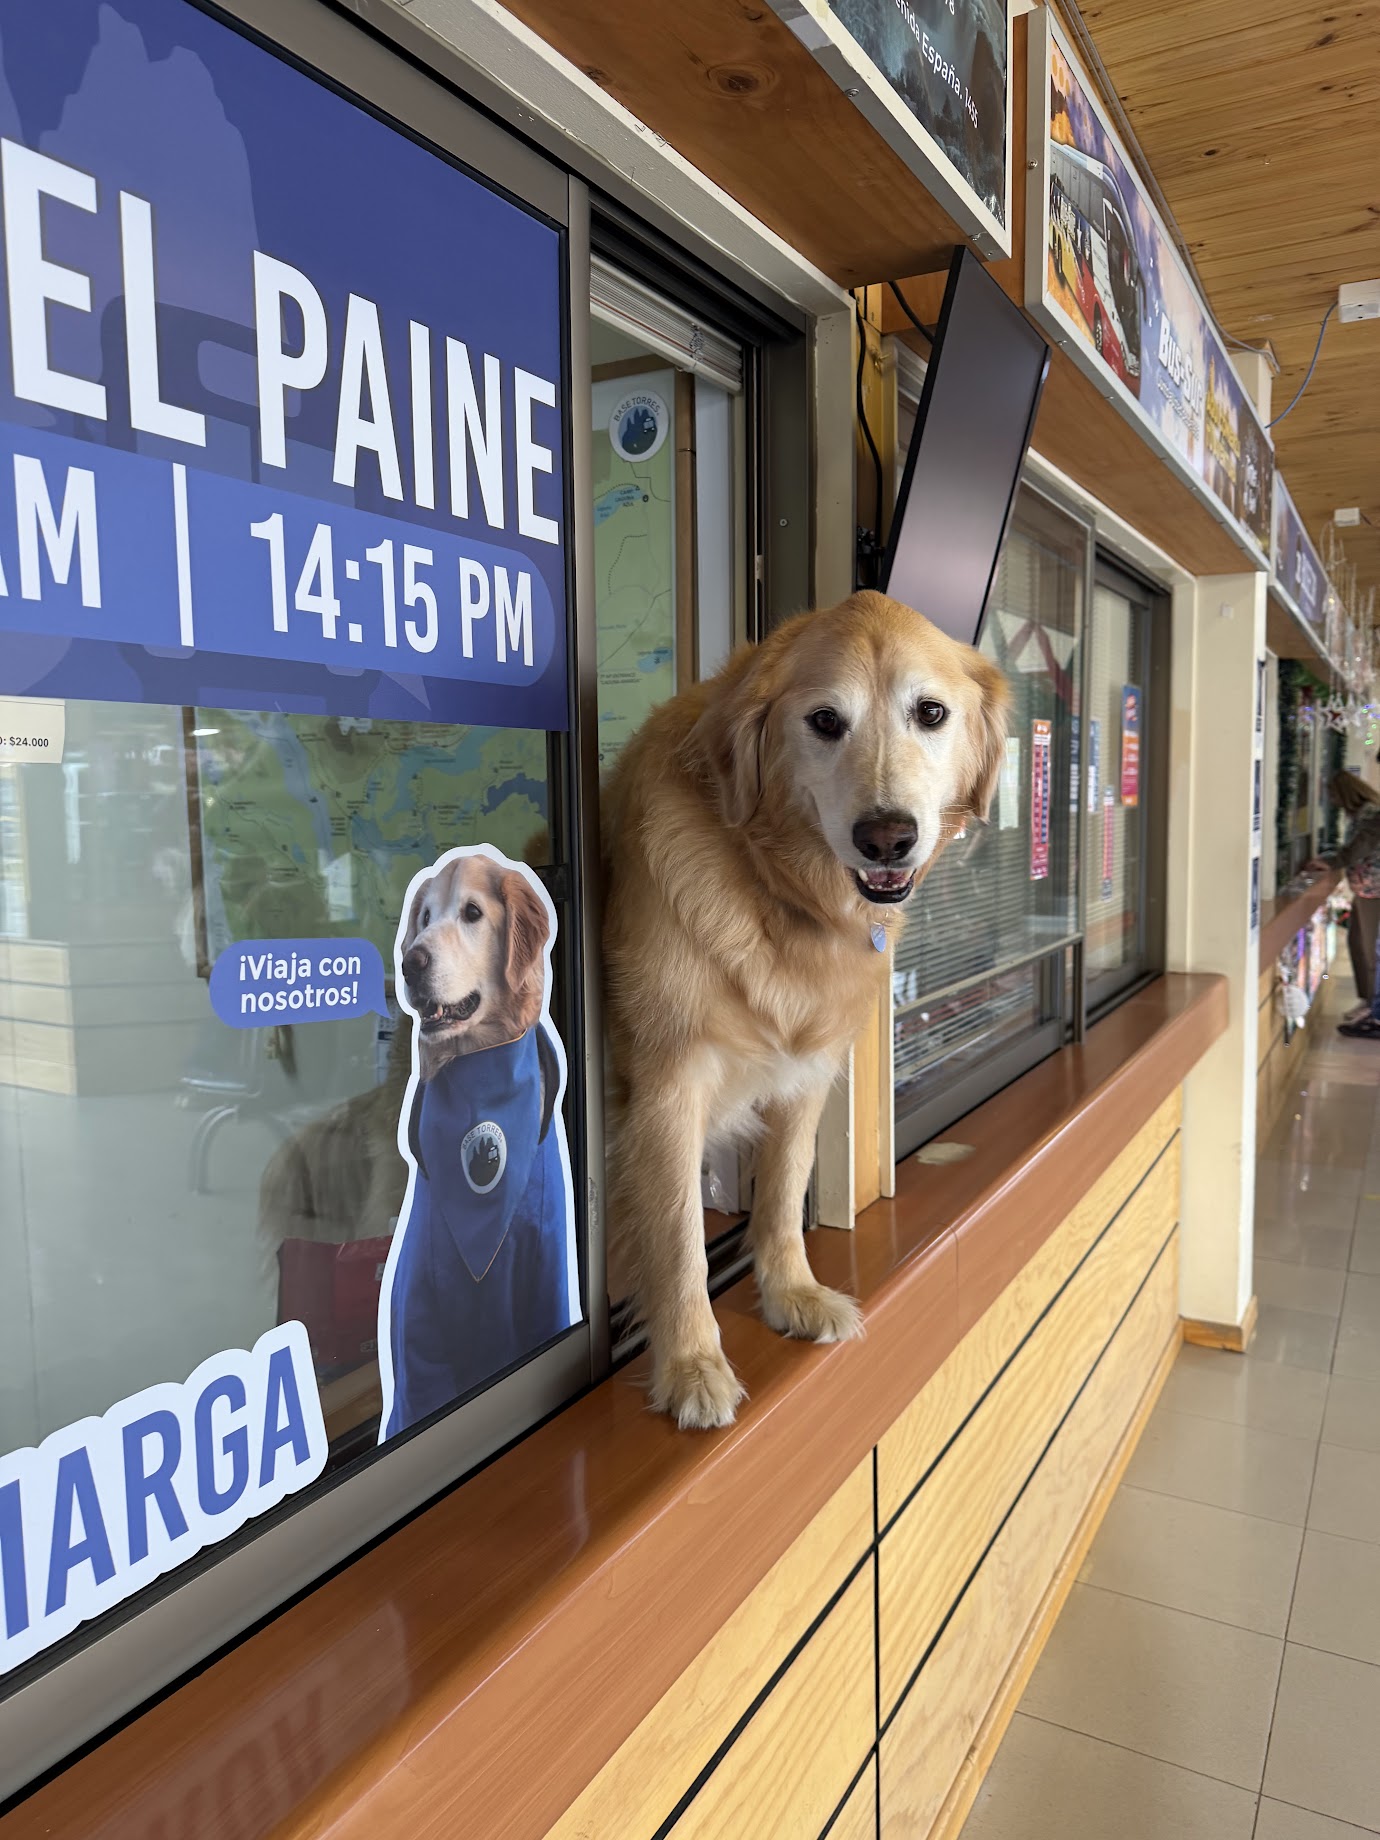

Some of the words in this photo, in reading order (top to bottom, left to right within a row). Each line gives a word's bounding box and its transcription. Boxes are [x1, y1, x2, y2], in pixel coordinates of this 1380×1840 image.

[921, 32, 963, 99] España.
[965, 87, 978, 128] 1455
[1, 137, 206, 447] EL
[253, 249, 559, 545] PAINE
[613, 400, 632, 422] BASE
[0, 453, 102, 608] M
[250, 512, 439, 653] 14:15
[459, 556, 534, 667] PM
[9, 736, 49, 748] $24.000
[239, 952, 312, 985] ¡Viaja
[318, 956, 361, 977] con
[240, 981, 359, 1014] nosotros!
